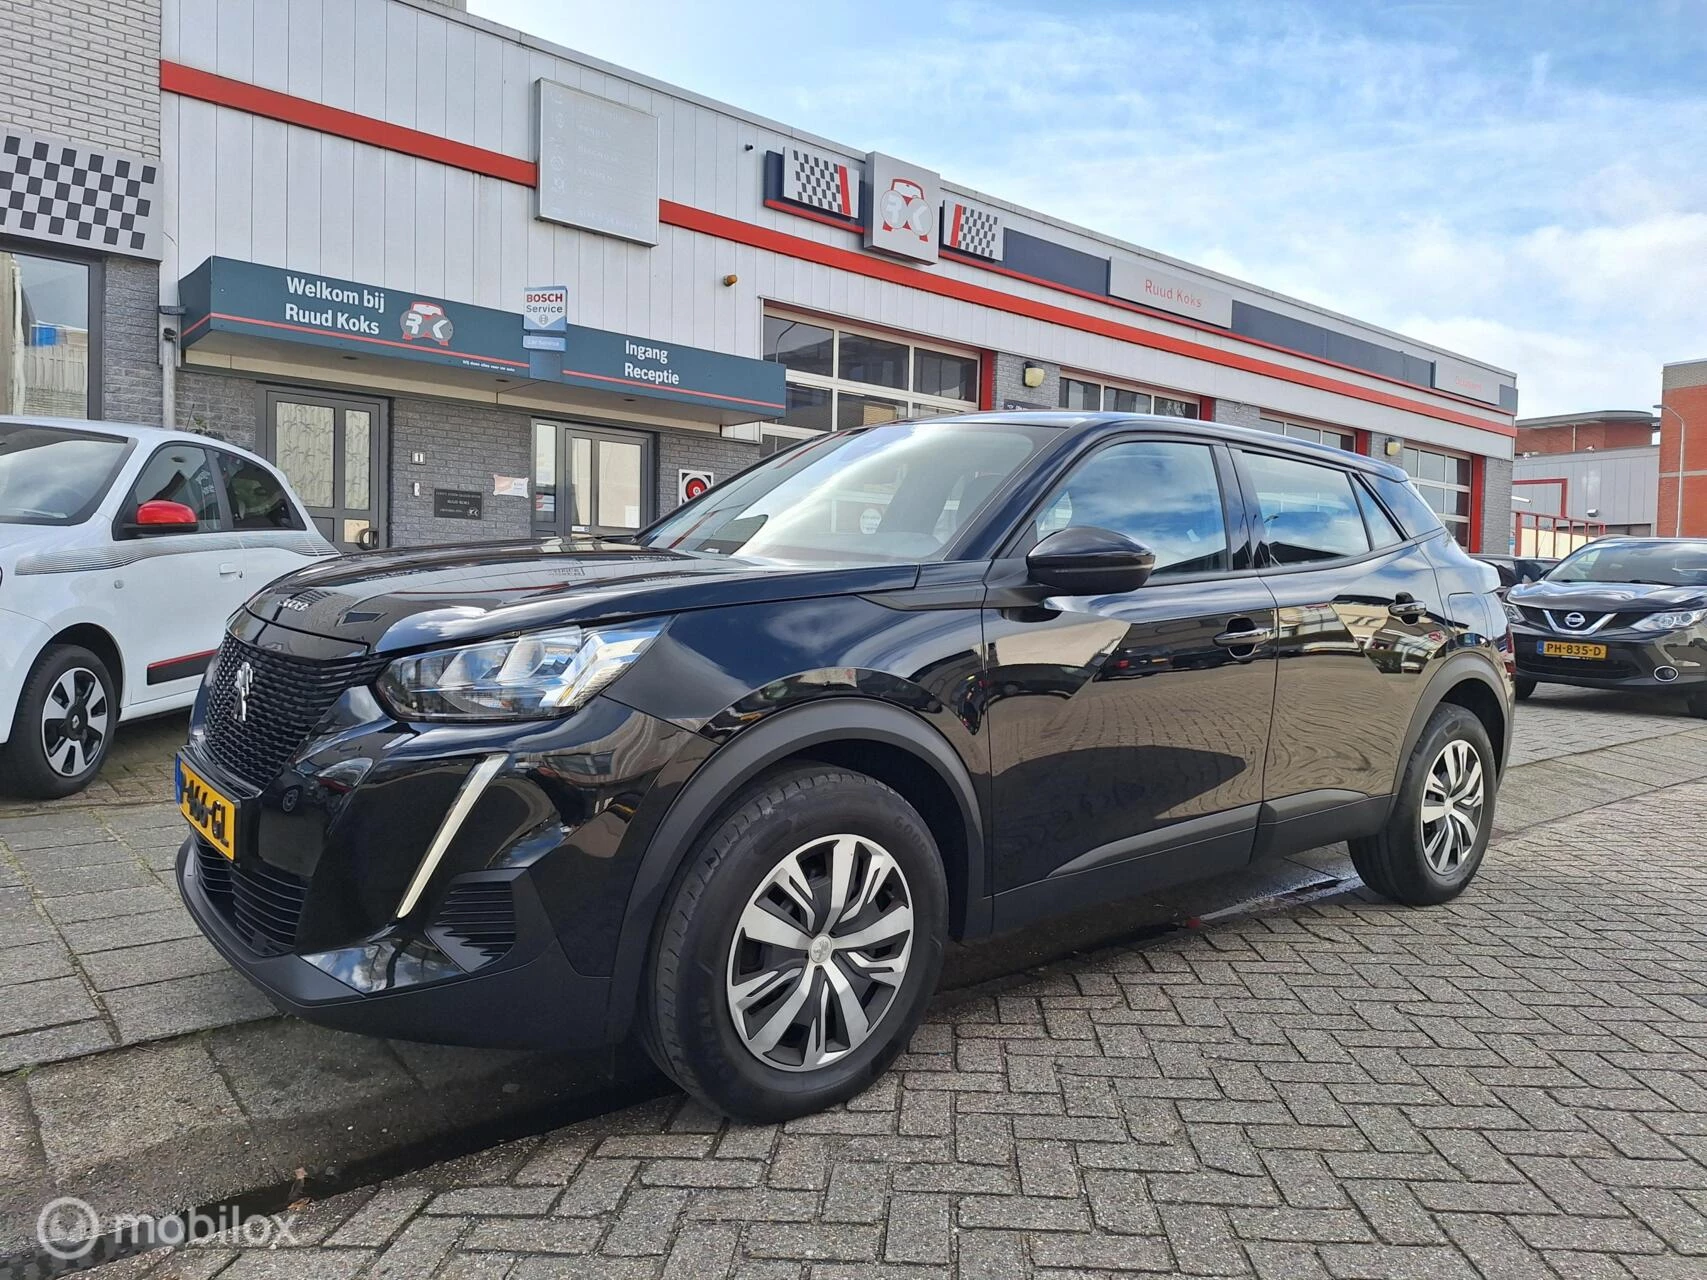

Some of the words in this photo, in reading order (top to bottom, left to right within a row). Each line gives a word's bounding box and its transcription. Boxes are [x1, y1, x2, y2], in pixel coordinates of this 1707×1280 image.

[286, 275, 358, 305] Welkom
[363, 289, 386, 314] bij
[526, 293, 563, 303] BOSCH
[1145, 279, 1173, 300] Ruud
[1176, 288, 1202, 308] Koks
[284, 303, 332, 327] Ruud
[337, 312, 380, 335] Koks
[526, 304, 563, 313] Service
[625, 339, 668, 364] Ingang
[624, 362, 680, 385] Receptie
[1546, 643, 1602, 656] PH-835-D
